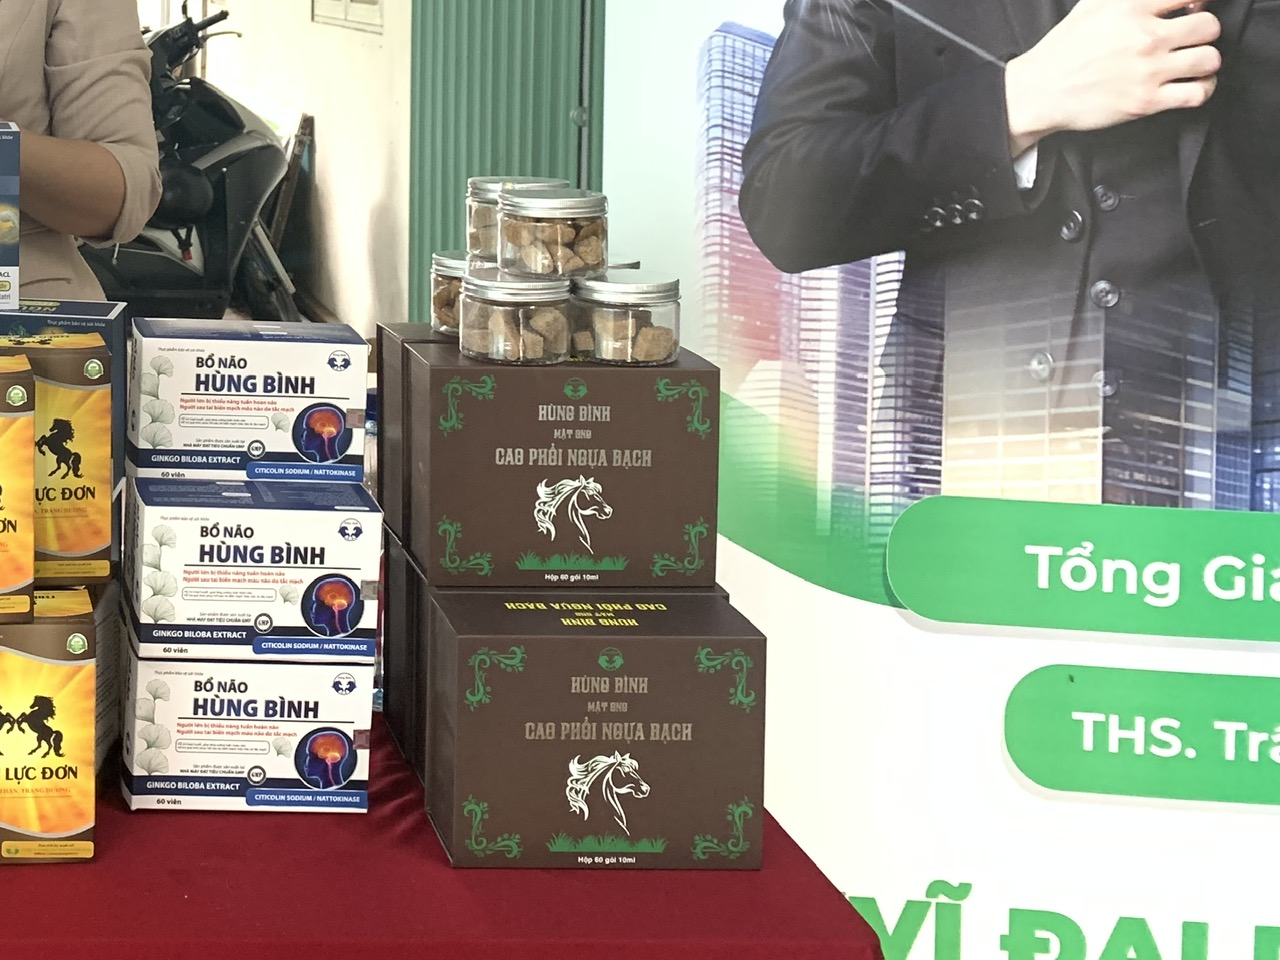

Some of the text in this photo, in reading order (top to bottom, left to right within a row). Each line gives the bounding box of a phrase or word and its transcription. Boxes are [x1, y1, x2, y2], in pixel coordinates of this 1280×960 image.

[196, 353, 248, 369] BỔ NÃO
[195, 370, 315, 395] HÙNG BÌNH
[538, 403, 611, 422] HÙNG BÌNH
[151, 454, 241, 464] GINKGO BILOBA EXTRACT
[495, 443, 652, 470] CAO PHỔI NGỰA BẠCH
[254, 467, 284, 475] CITICOLIN
[313, 469, 356, 477] NATTOKINASE
[35, 485, 96, 505] ỰC ĐƠN
[200, 522, 254, 539] BỔ NÃO
[199, 541, 325, 565] HÙNG BÌNH
[544, 574, 559, 582] Hộp
[570, 573, 581, 582] gói
[582, 573, 599, 581] 10ml
[1024, 541, 1181, 608] Tổng
[153, 629, 247, 639] GINKGO BILOBA EXTRACT
[293, 642, 319, 650] SODIUM
[323, 643, 367, 651] NATTOKINASE
[194, 677, 248, 693] BỔ NÃO
[571, 675, 648, 693] HÙNG BÌNH
[193, 694, 319, 719] HÙNG BÌNH
[525, 716, 693, 744] CAO PHỔI NGỰA BẠCH
[1071, 711, 1196, 759] THS.
[5, 764, 37, 785] LỰC
[40, 763, 78, 780] ĐƠN
[146, 781, 240, 791] GINKGO BILOBA EXTRACT
[286, 794, 312, 802] SODIUM
[316, 795, 360, 803] NATTOKINASE
[577, 856, 593, 864] Hộp
[605, 855, 617, 865] gói
